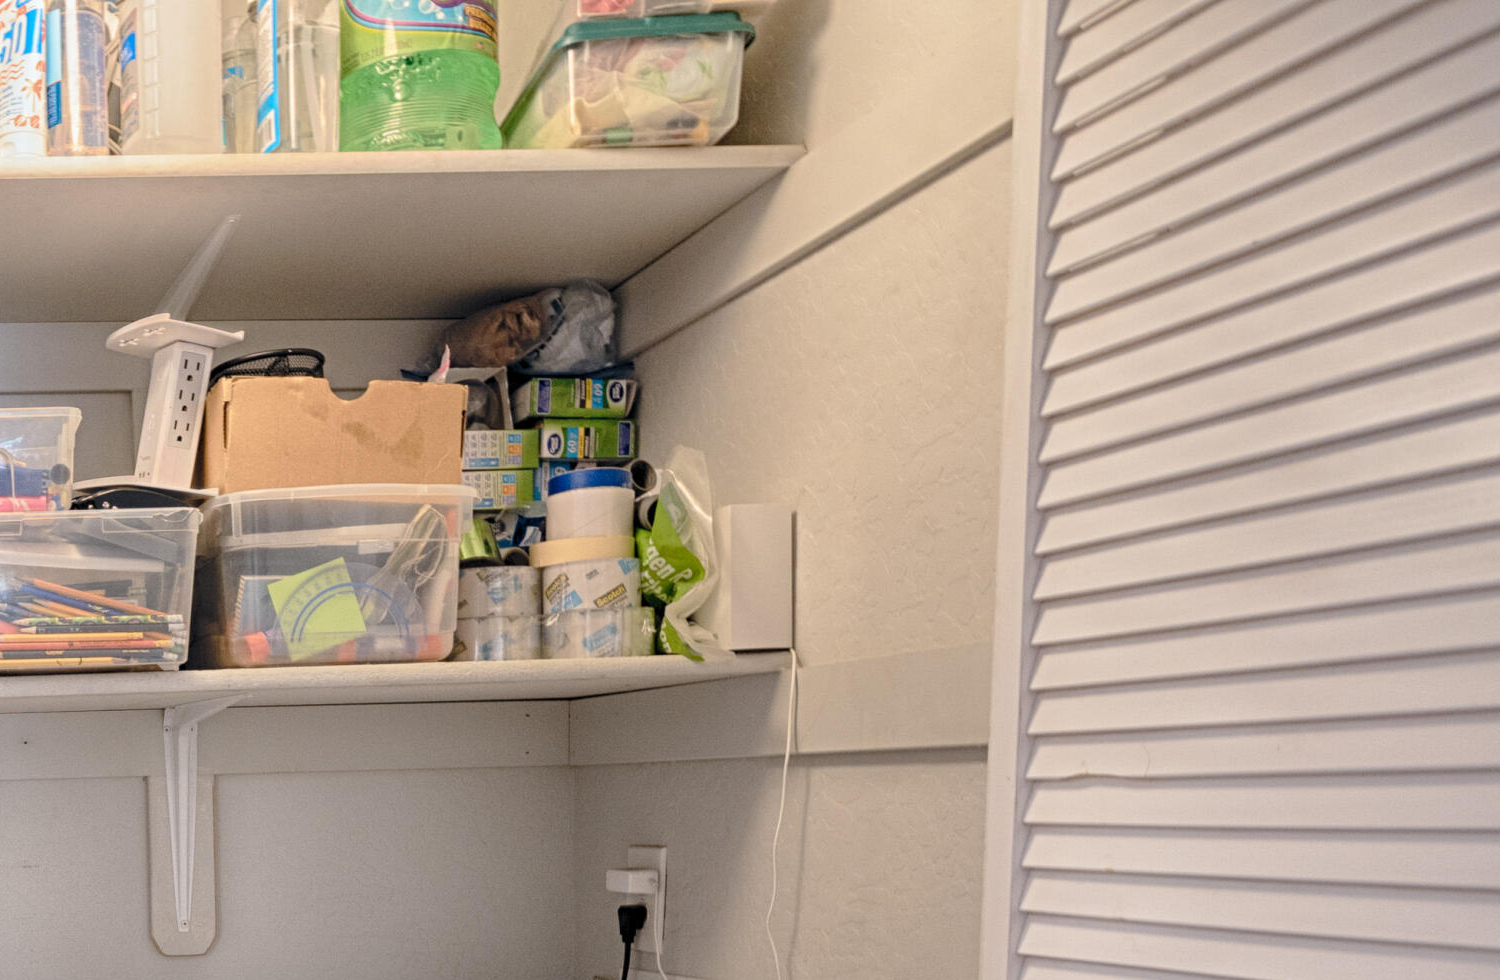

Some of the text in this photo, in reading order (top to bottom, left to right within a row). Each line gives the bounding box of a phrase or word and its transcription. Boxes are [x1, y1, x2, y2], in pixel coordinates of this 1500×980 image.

[594, 383, 604, 397] 60
[567, 440, 577, 454] 60
[643, 544, 676, 580] gen
[595, 585, 626, 607] Scotch
